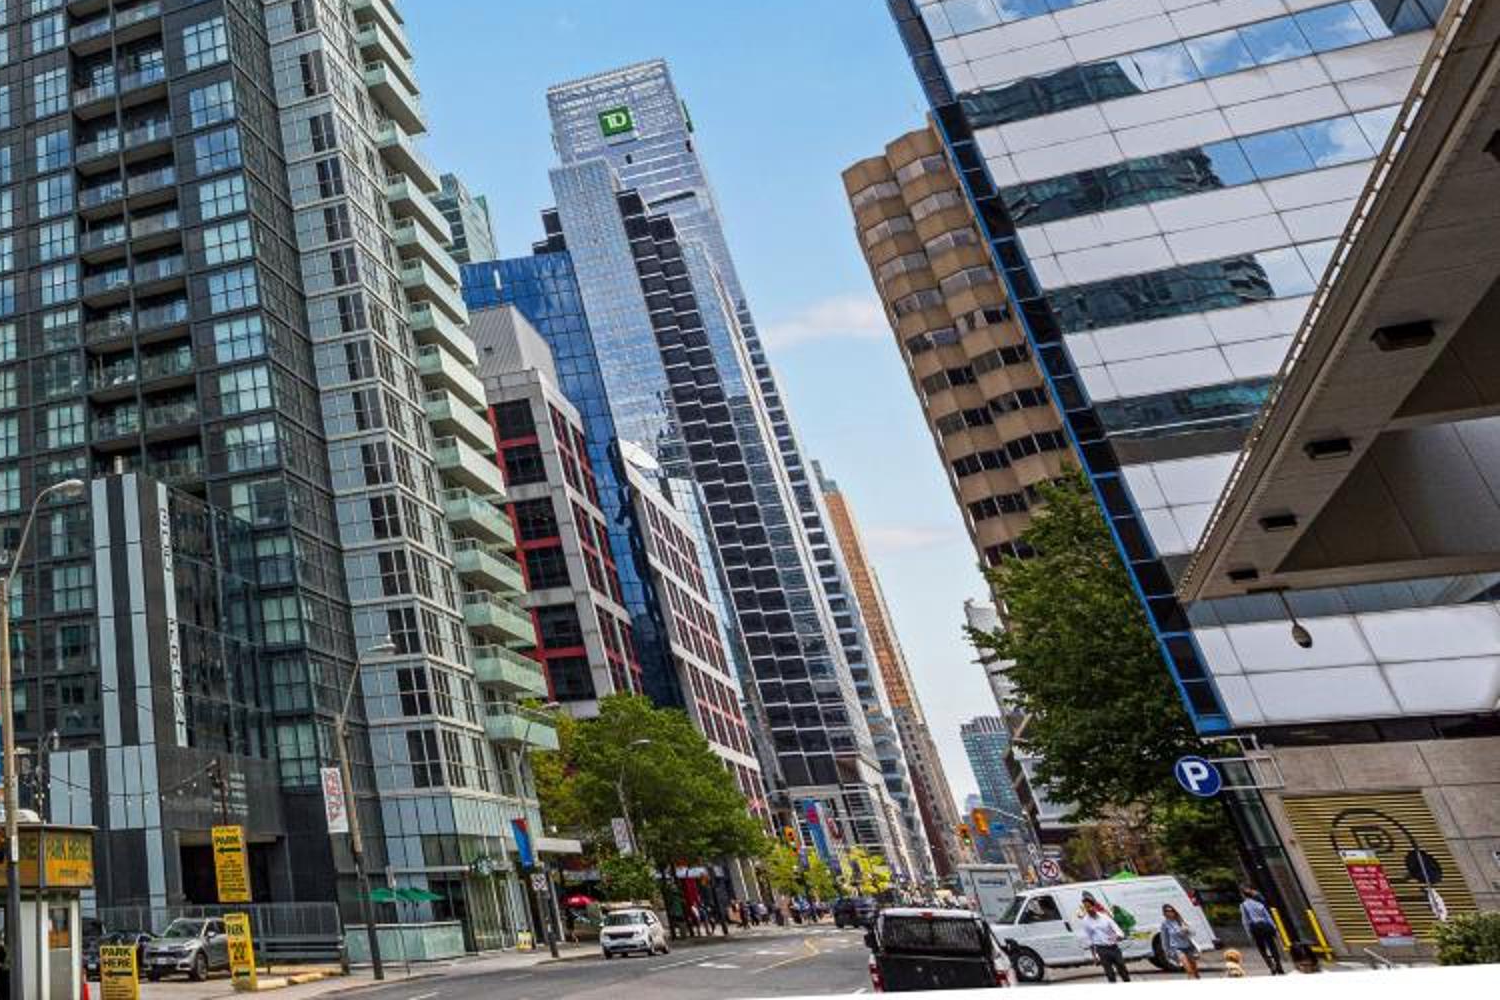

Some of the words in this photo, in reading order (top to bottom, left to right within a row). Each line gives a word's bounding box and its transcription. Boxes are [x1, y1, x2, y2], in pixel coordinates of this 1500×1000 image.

[603, 112, 627, 128] TD
[1181, 761, 1209, 790] P
[102, 947, 132, 957] PARK
[102, 957, 132, 969] HERE
